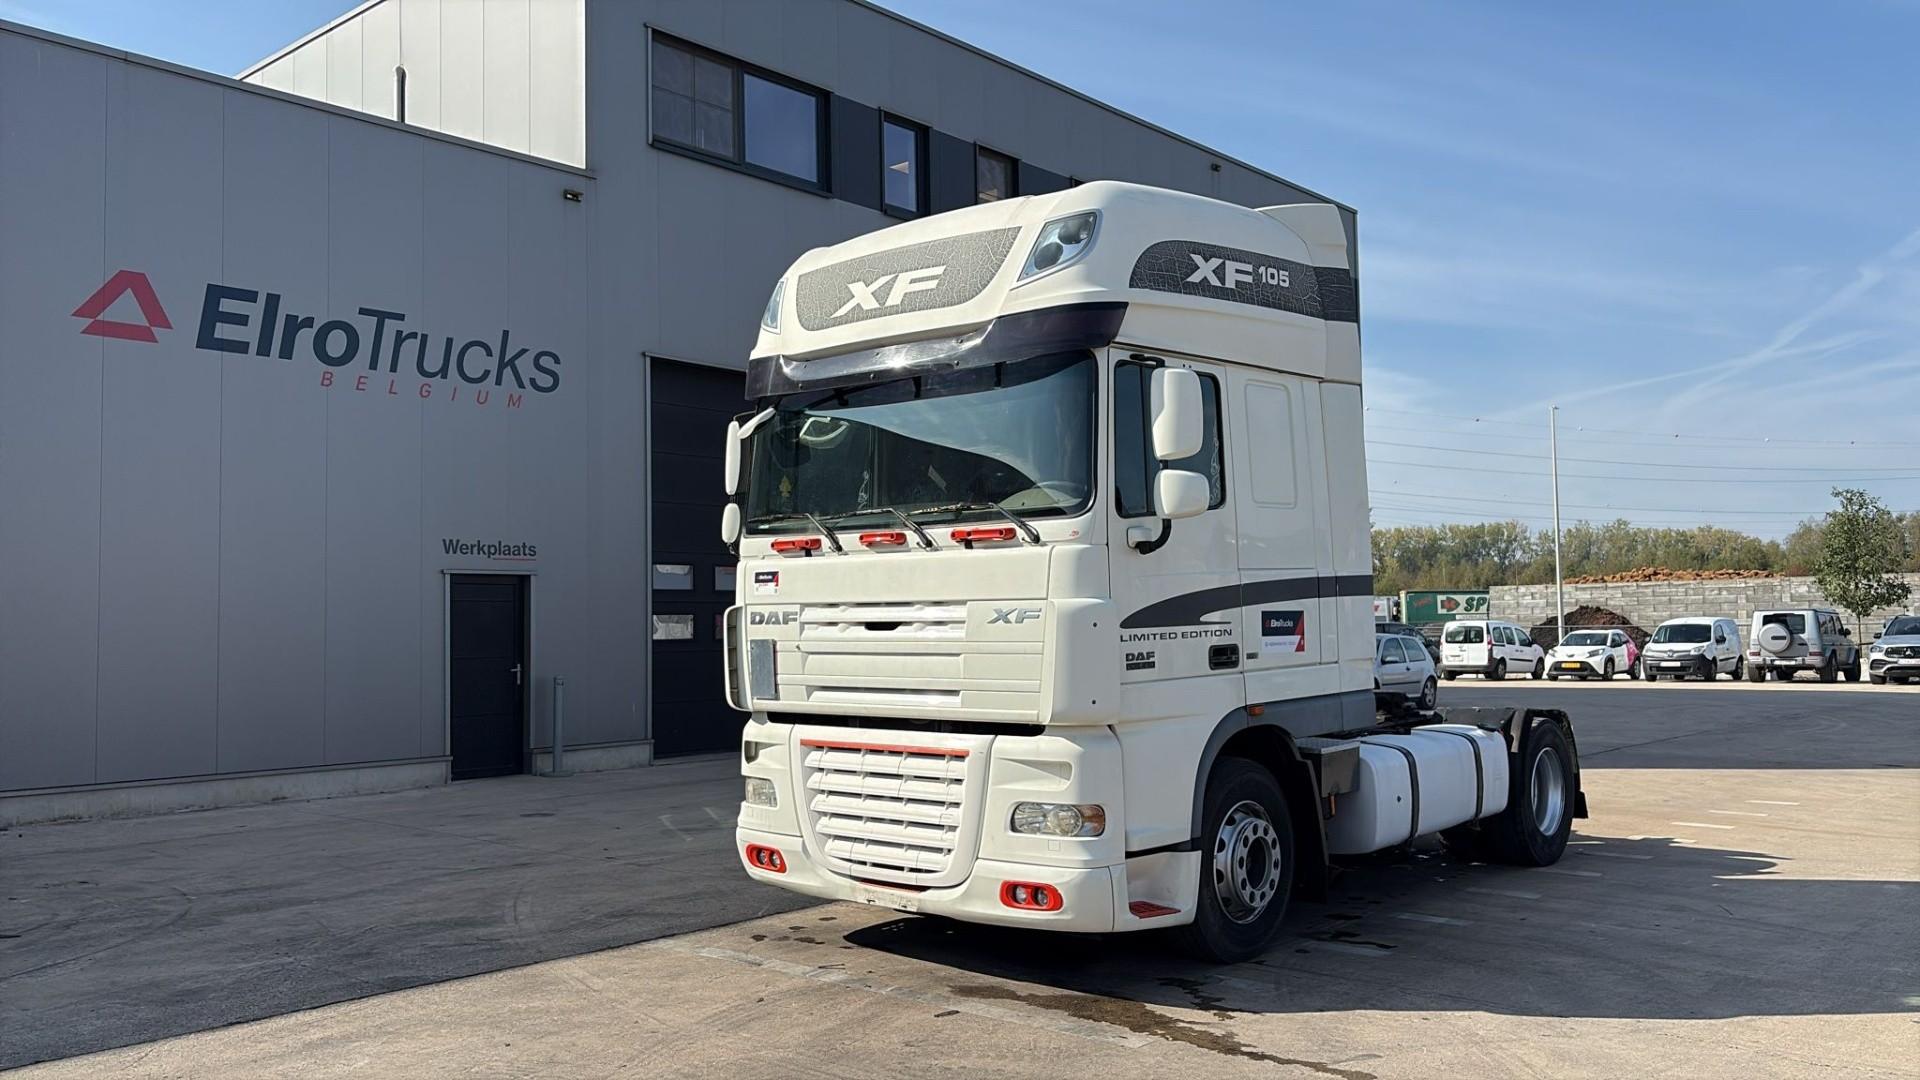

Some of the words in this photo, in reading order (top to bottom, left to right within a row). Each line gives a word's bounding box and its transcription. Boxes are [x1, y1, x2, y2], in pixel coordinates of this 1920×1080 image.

[1186, 253, 1253, 289] XF
[1258, 266, 1290, 288] 105
[829, 265, 947, 318] XF
[195, 283, 562, 394] ElroTrucks
[320, 371, 523, 409] BELGIUM
[442, 538, 537, 559] Werkplaats
[750, 611, 799, 625] DAF
[986, 607, 1042, 624] XF
[1120, 632, 1178, 642] LIMITED
[1181, 628, 1232, 639] EDITION
[1125, 651, 1155, 662] DAF
